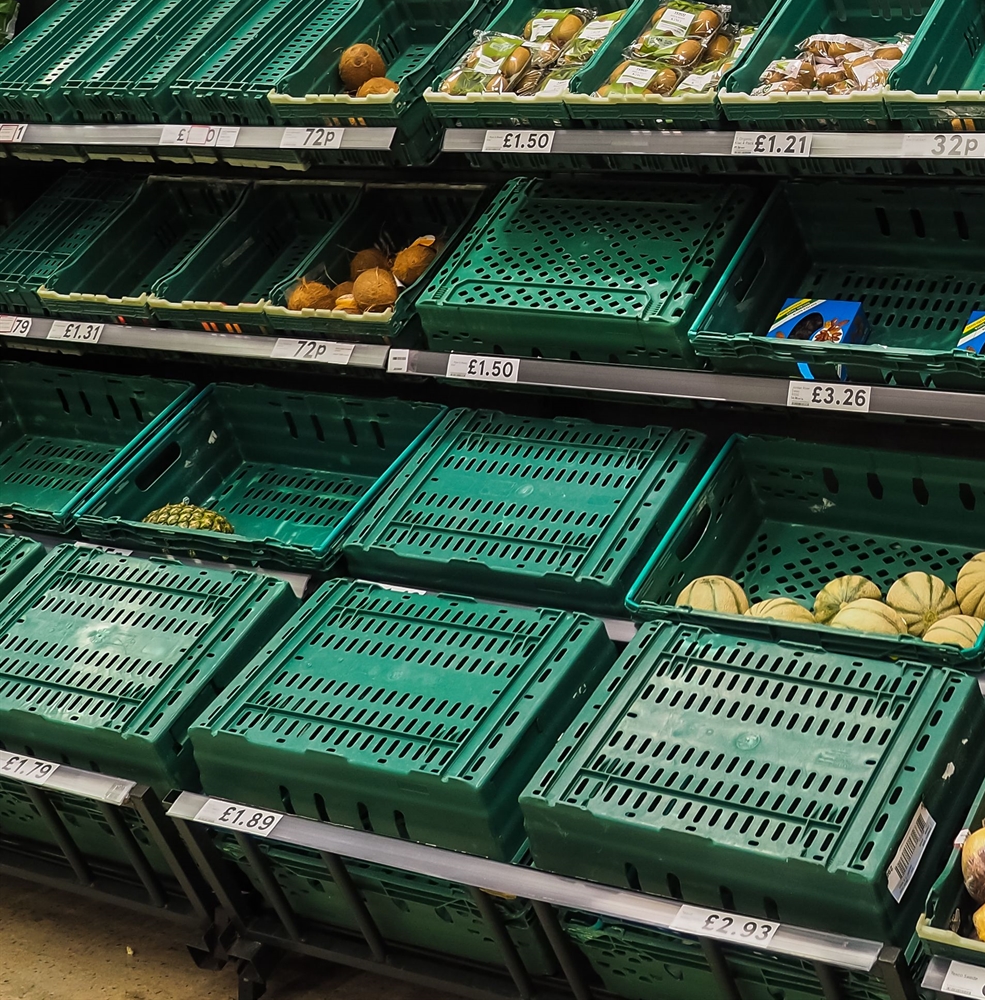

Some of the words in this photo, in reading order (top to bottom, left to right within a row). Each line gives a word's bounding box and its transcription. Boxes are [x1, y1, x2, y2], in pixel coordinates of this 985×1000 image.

[302, 128, 336, 147] 72p
[502, 132, 550, 149] £1.50
[753, 134, 807, 154] £1.21
[930, 134, 980, 156] 32p
[63, 323, 101, 341] £1.31
[293, 340, 327, 360] 72p
[467, 358, 514, 378] £1.50
[811, 386, 867, 407] £3.26
[1, 756, 53, 779] £1.79
[218, 806, 276, 831] £1.89
[701, 914, 773, 941] £2.93
